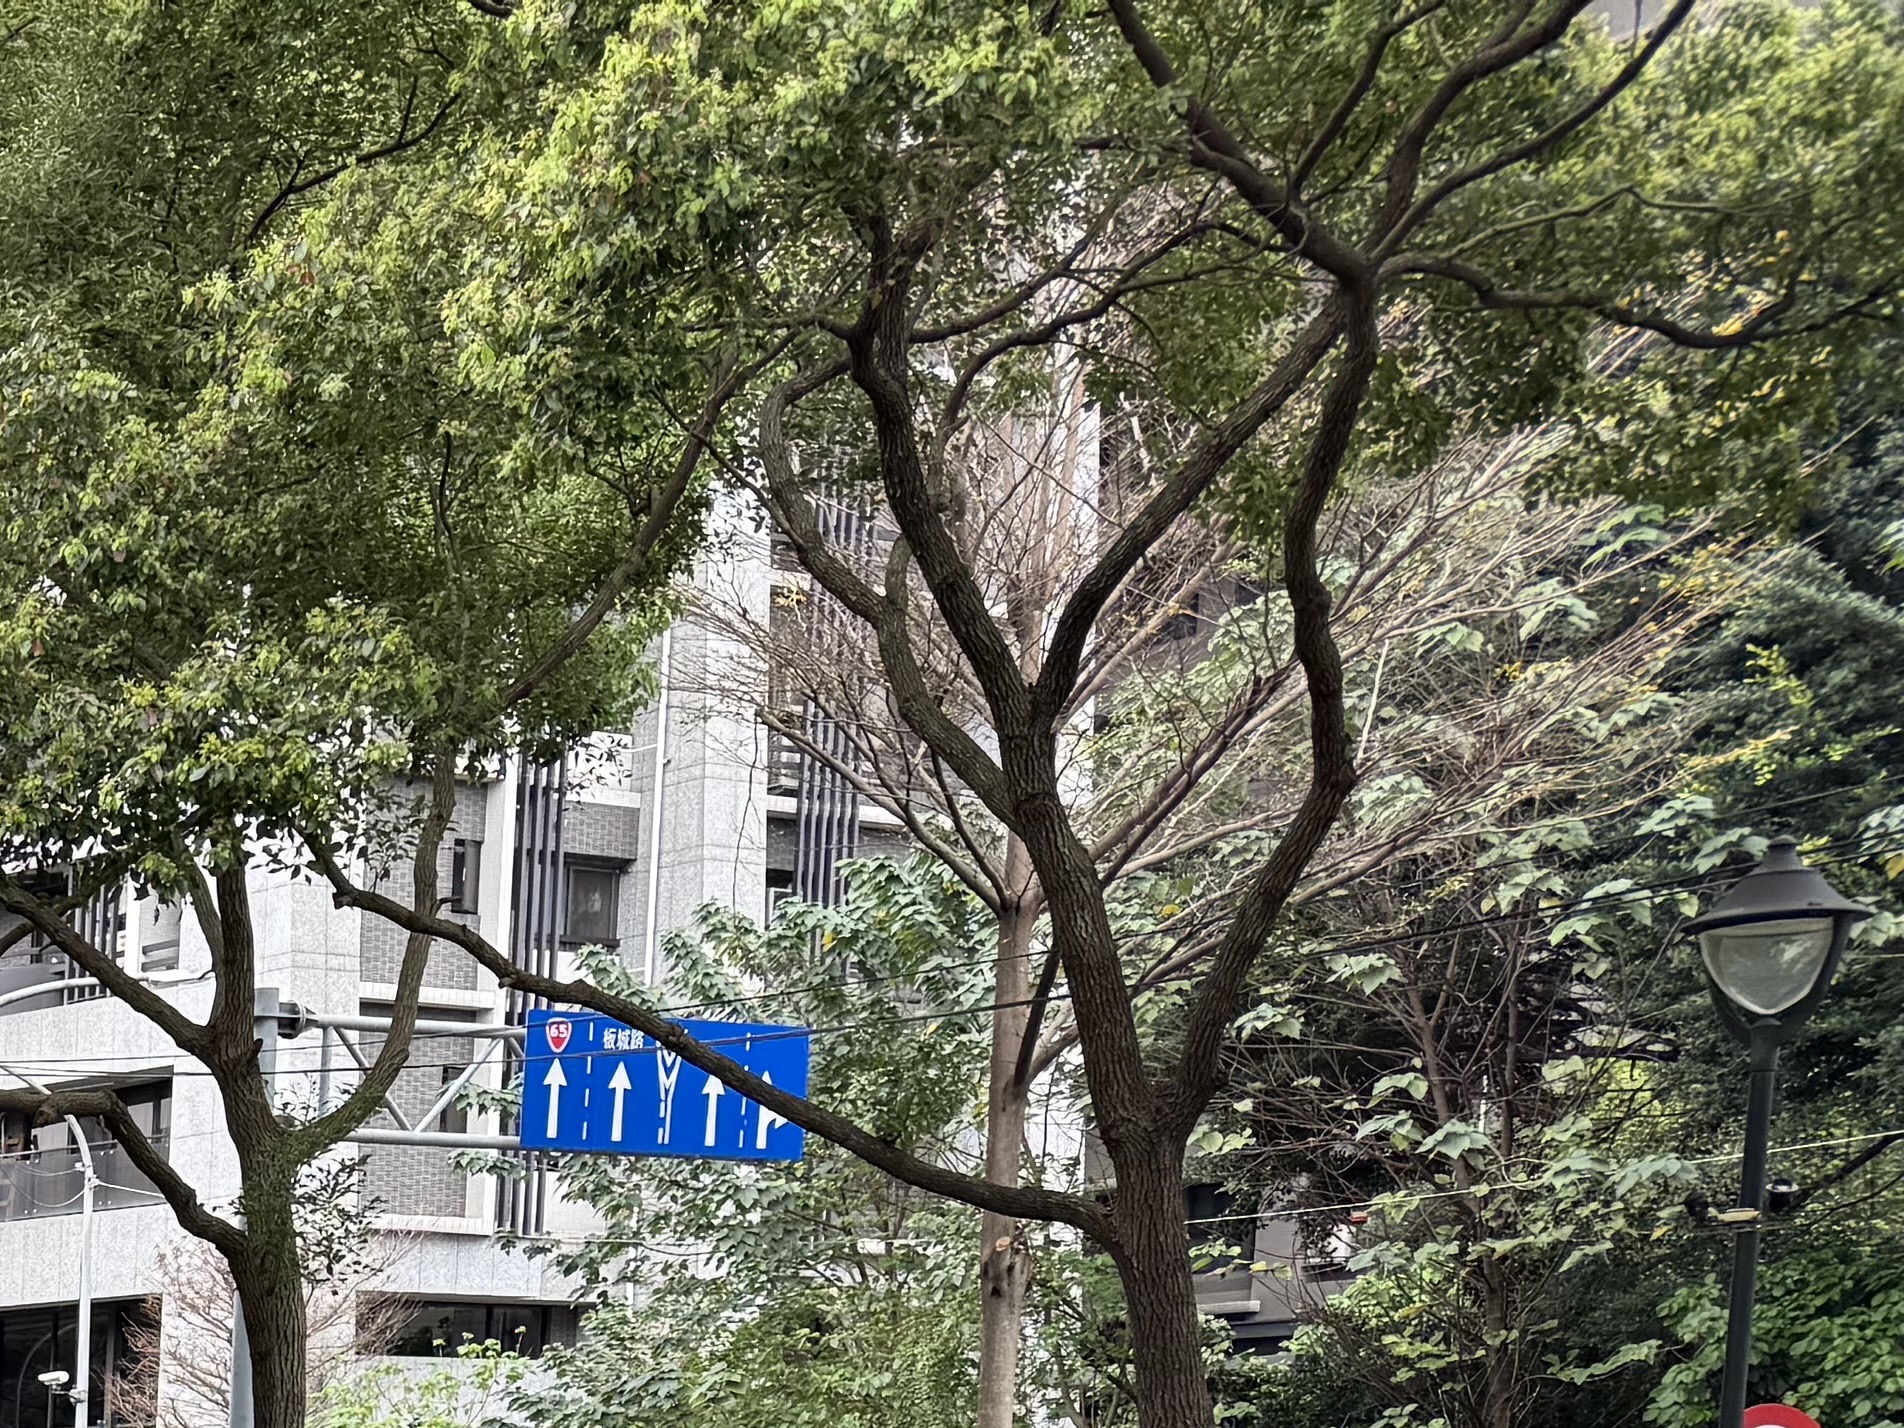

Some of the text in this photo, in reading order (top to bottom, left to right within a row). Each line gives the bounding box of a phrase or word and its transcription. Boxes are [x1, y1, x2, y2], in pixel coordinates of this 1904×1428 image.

[549, 1023, 568, 1038] 65
[603, 1027, 645, 1051] 板城路
